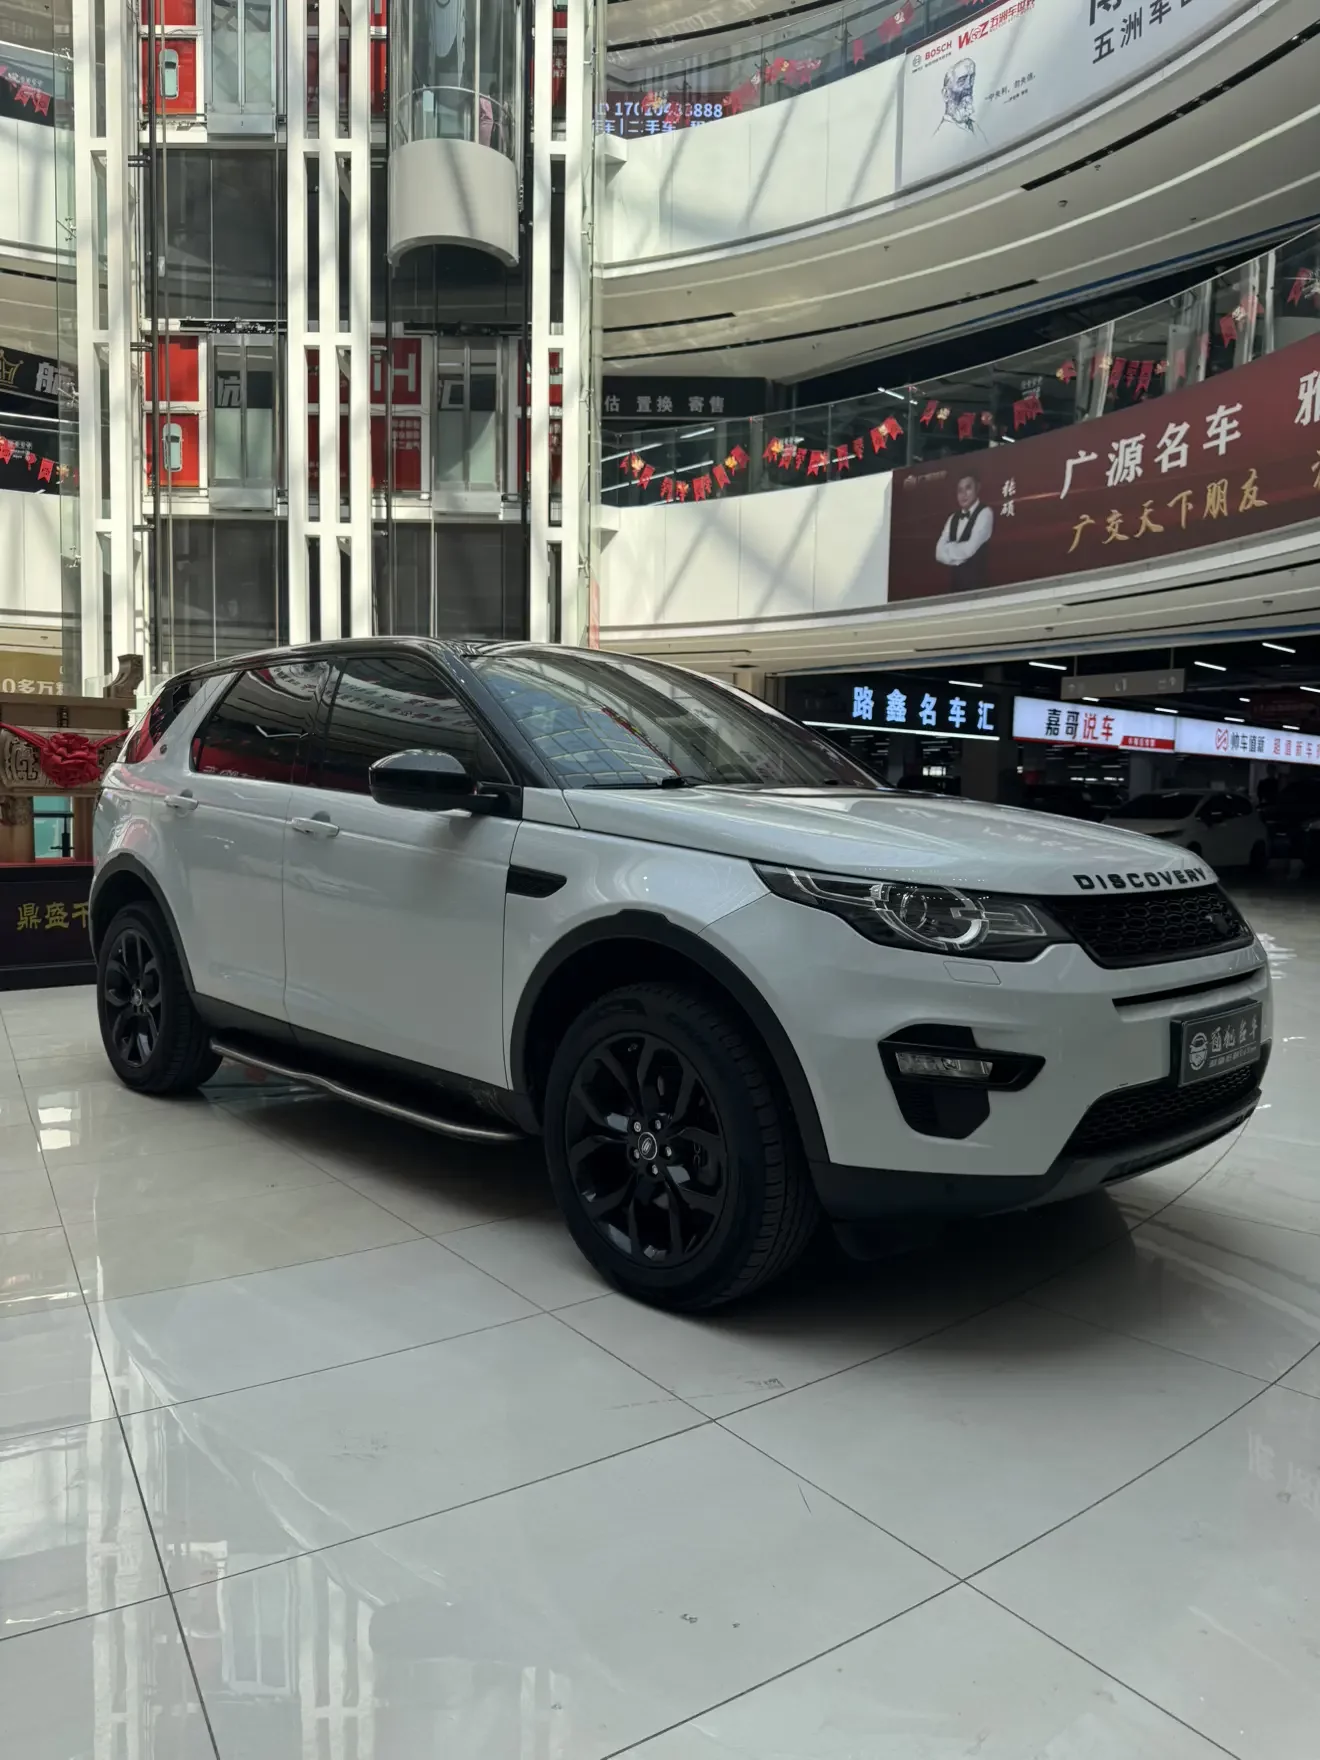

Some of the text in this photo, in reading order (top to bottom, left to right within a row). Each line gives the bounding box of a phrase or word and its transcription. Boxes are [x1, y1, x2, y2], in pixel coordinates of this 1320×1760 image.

[924, 40, 953, 60] BOSCH
[1092, 0, 1193, 64] 五洲车
[1060, 403, 1243, 500] 广源名车
[1068, 468, 1269, 554] 广交天下朋友
[852, 686, 995, 730] 路鑫名车汇
[1045, 708, 1115, 741] 嘉哥说车
[1072, 867, 1206, 890] DISCOVERY
